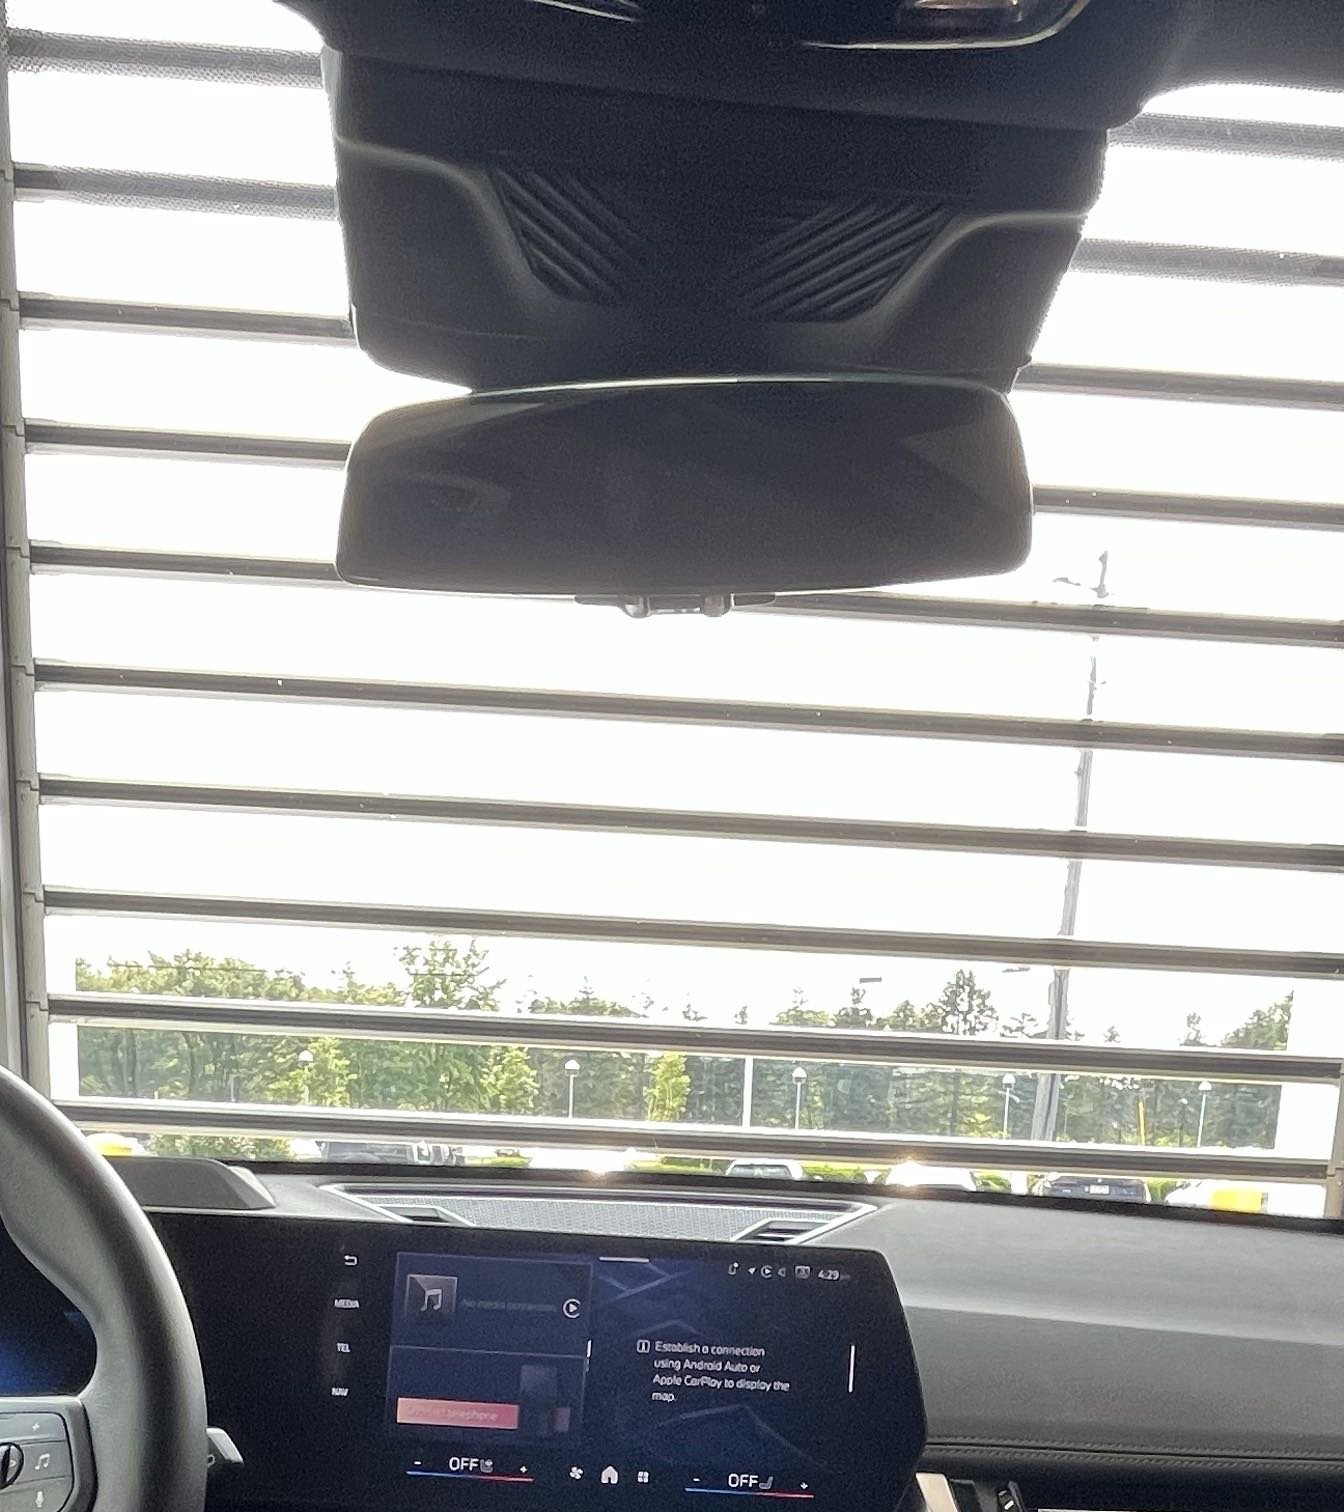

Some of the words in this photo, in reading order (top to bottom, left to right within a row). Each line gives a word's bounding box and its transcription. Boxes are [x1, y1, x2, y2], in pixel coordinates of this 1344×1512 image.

[337, 1343, 351, 1353] TEL
[655, 1341, 701, 1354] Establish
[701, 1345, 709, 1354] a
[711, 1345, 766, 1357] connection
[653, 1359, 681, 1371] using
[683, 1359, 723, 1371] Android
[724, 1360, 748, 1373] Auto
[749, 1364, 761, 1374] or
[653, 1373, 683, 1386] Apple
[684, 1374, 723, 1389] CarPlay
[724, 1378, 735, 1389] to
[736, 1378, 772, 1392] display
[773, 1381, 790, 1392] the
[331, 1387, 349, 1397] NAV
[449, 1456, 480, 1471] OFF
[728, 1473, 759, 1488] OFF
